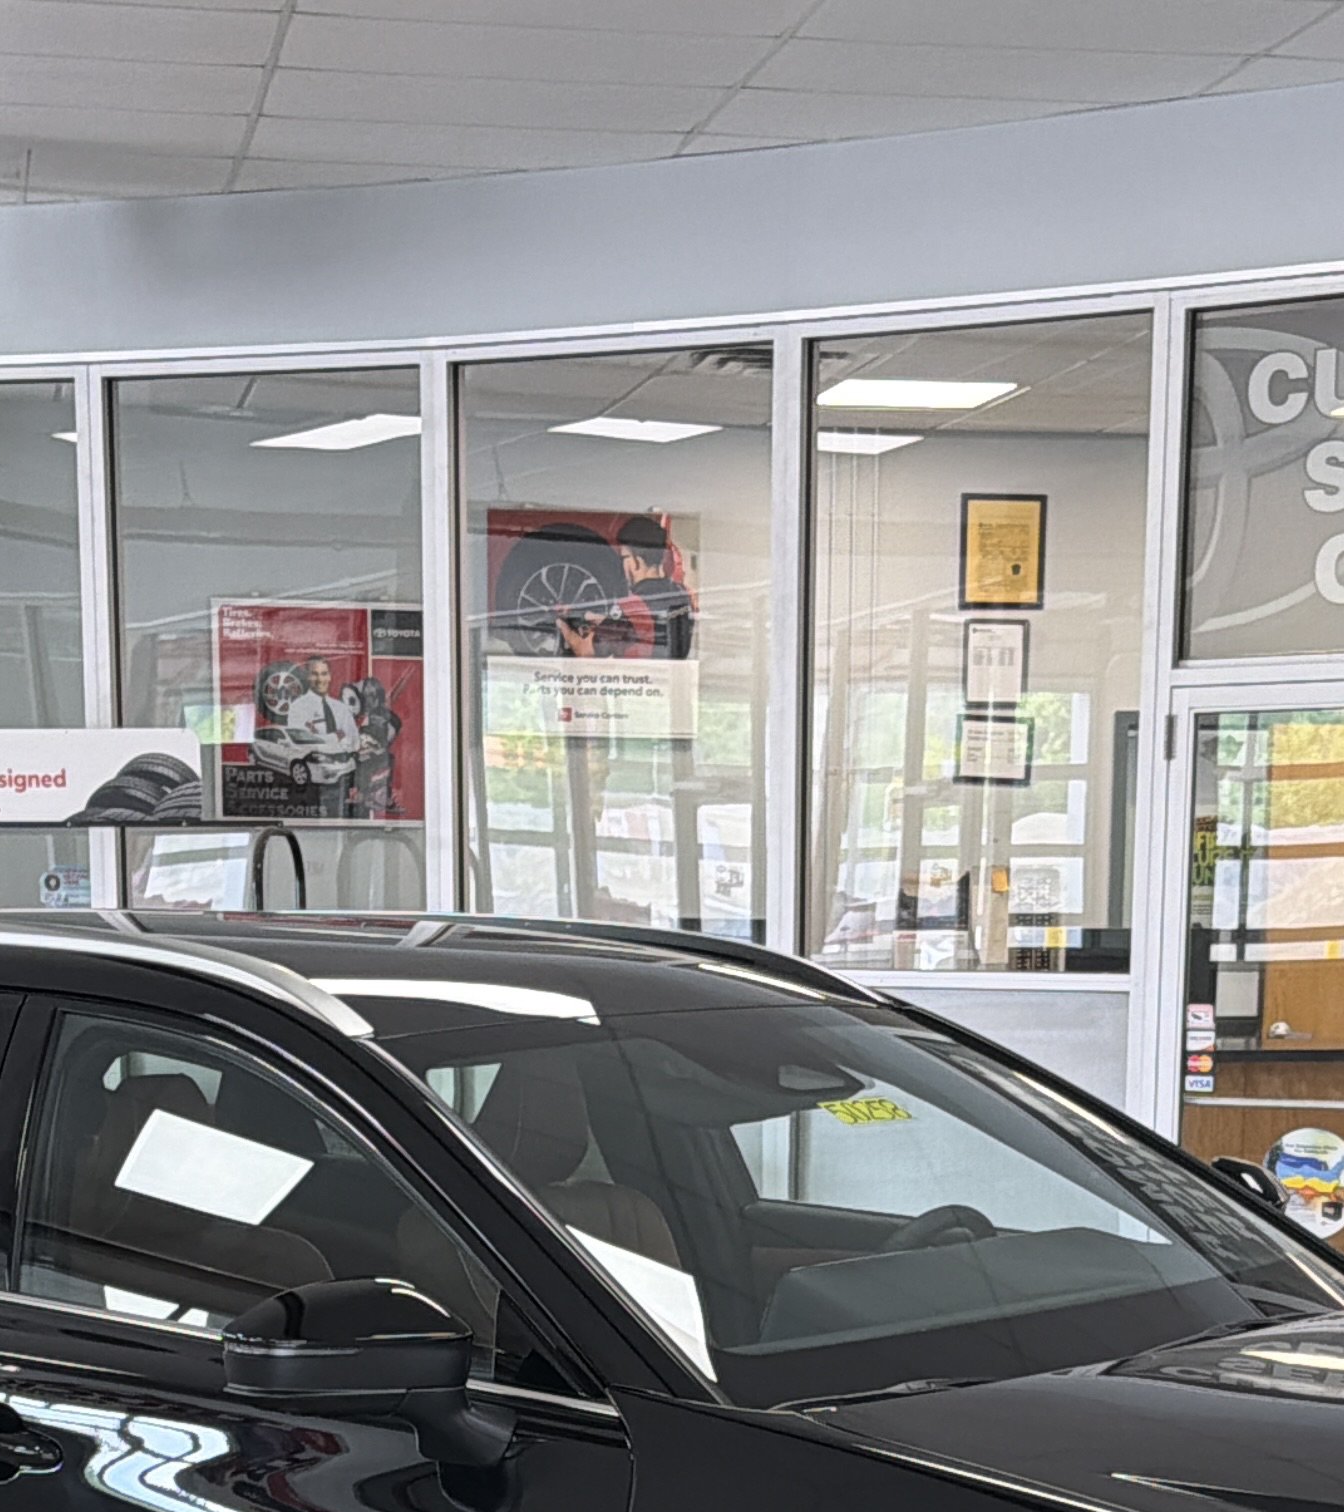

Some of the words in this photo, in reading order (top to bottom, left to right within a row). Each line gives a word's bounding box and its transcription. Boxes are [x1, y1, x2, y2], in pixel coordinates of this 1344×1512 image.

[387, 629, 421, 638] TOYOTA
[534, 671, 574, 684] Service
[576, 674, 598, 686] you
[600, 674, 620, 684] can
[553, 686, 576, 697] you
[577, 686, 597, 696] can
[599, 685, 643, 697] depend
[224, 767, 275, 784] PARTS
[1188, 1080, 1211, 1089] VISA
